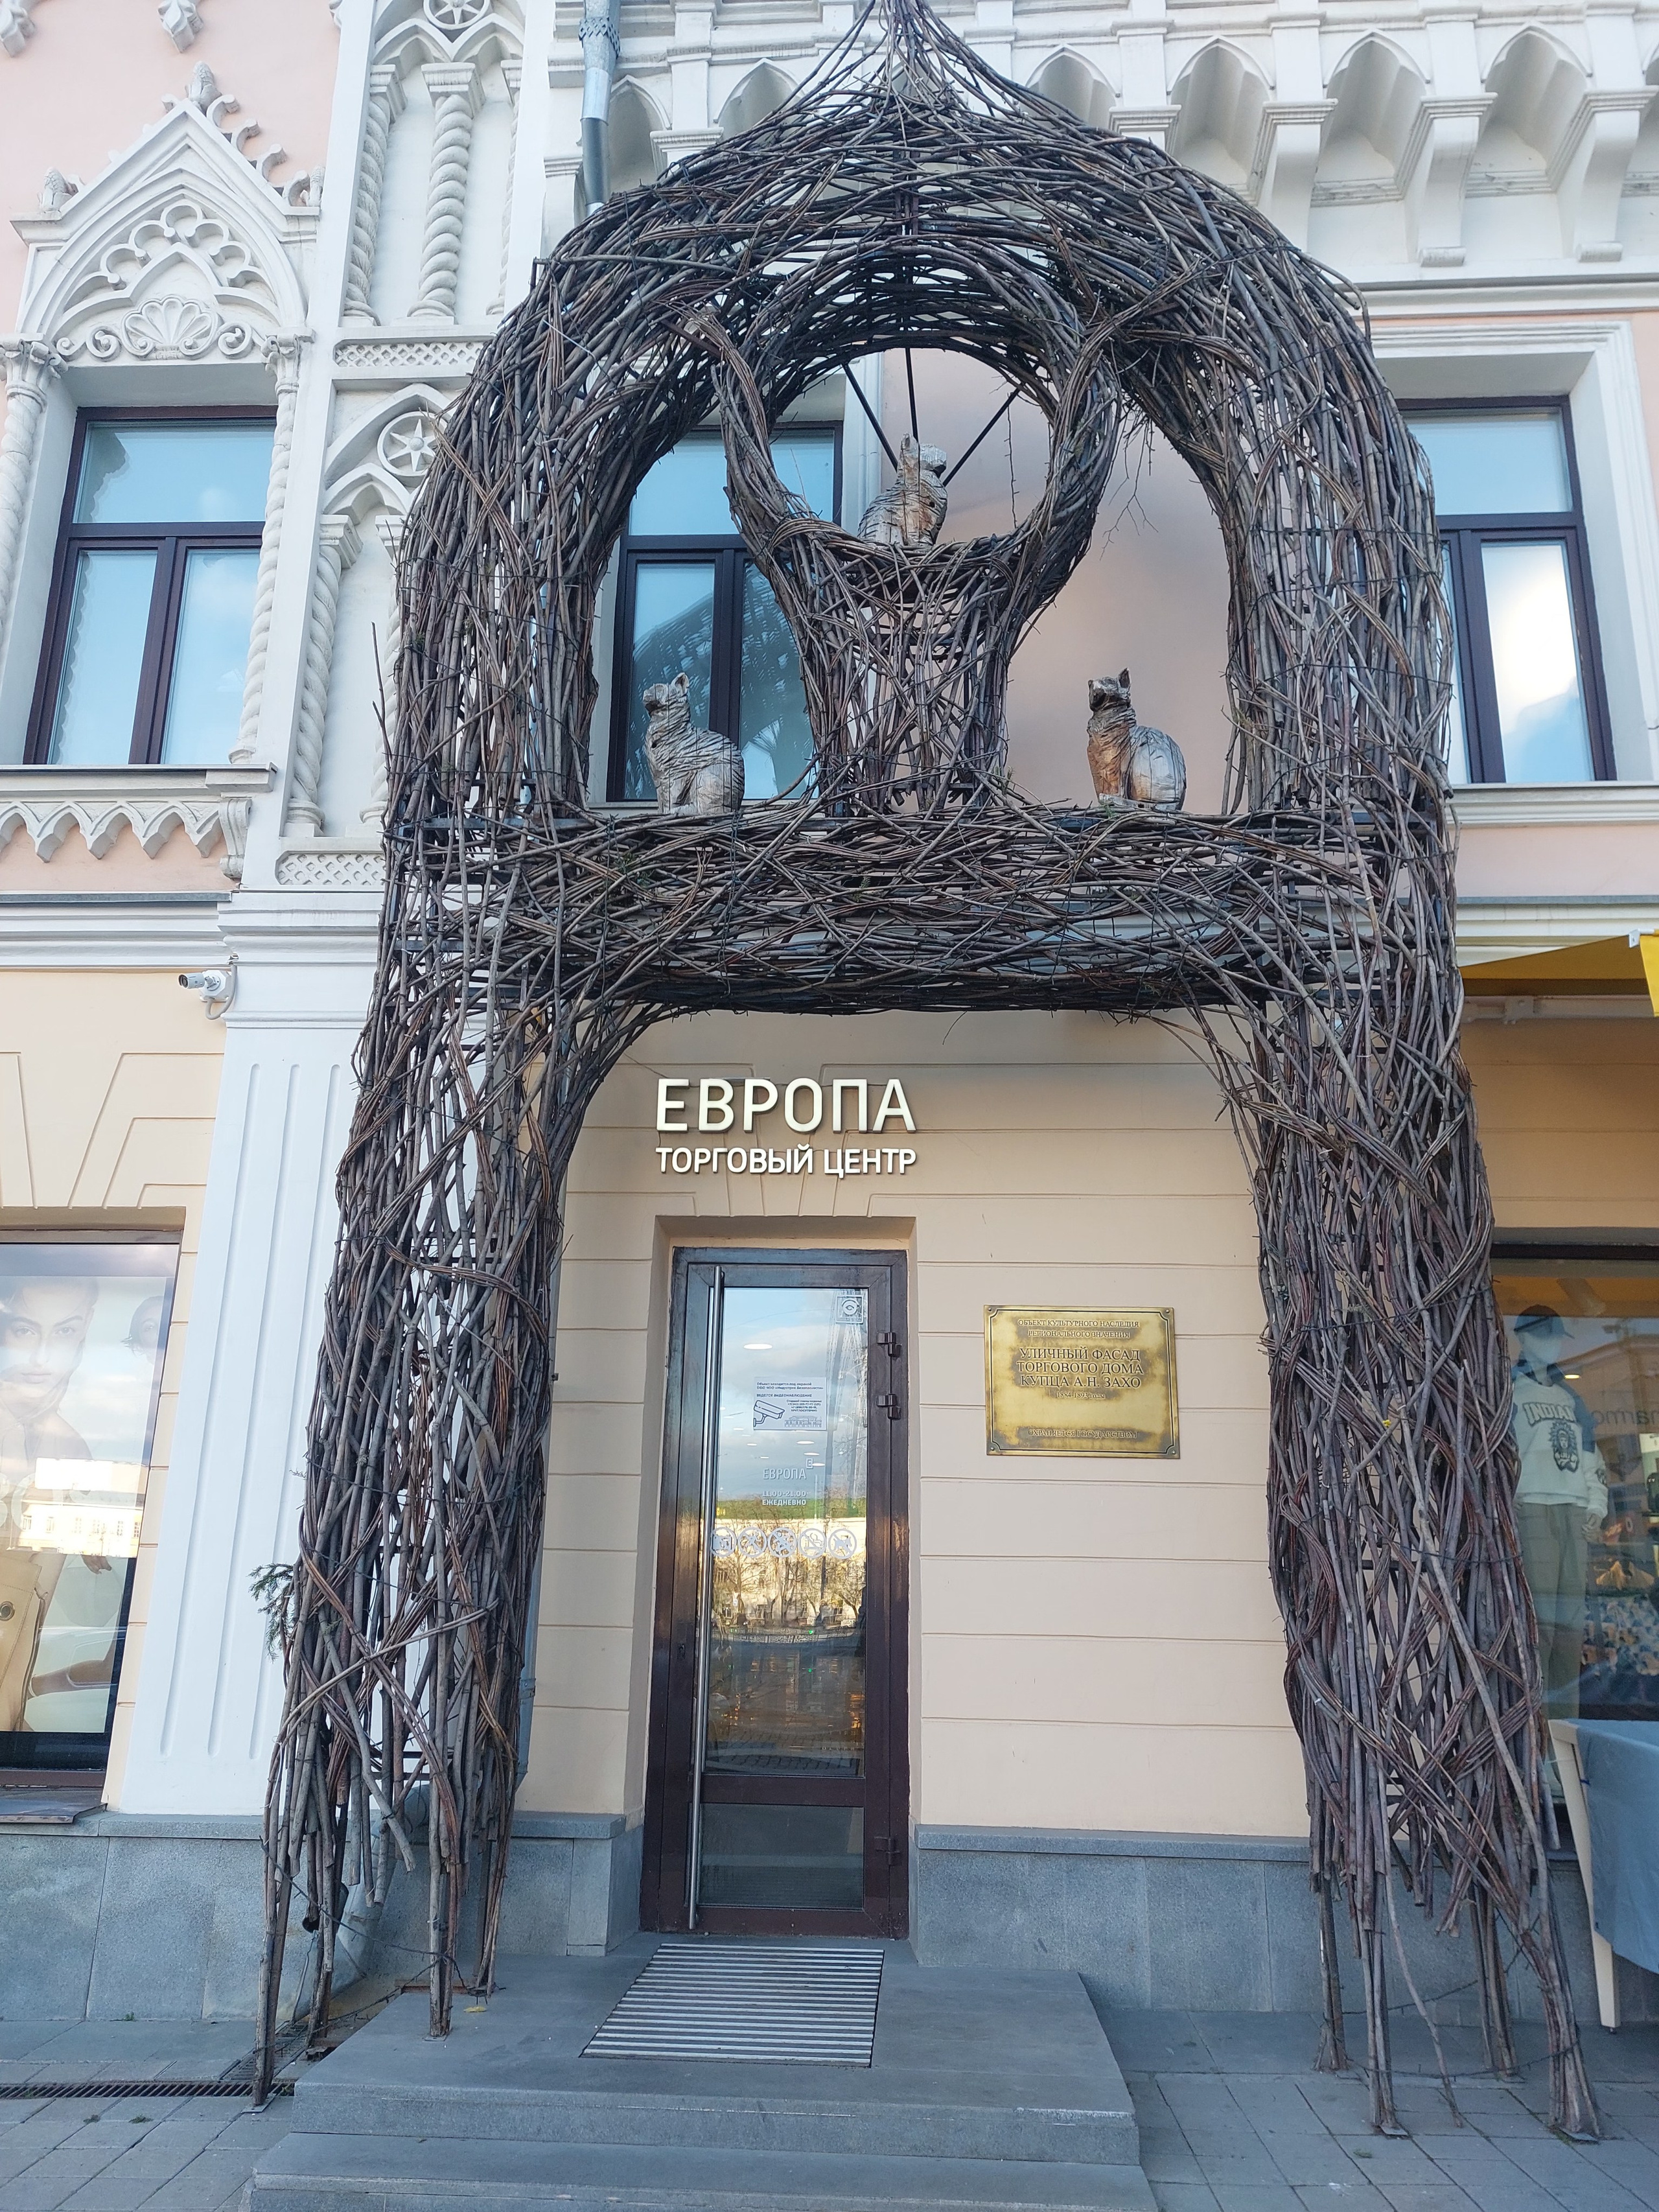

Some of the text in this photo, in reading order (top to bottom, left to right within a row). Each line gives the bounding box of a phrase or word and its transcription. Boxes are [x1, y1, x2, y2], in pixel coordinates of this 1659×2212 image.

[656, 1078, 916, 1133] ЕВРОПА
[655, 1143, 916, 1179] ТОРГОВЫЙ ЦЕНТР
[1019, 1346, 1140, 1362] УЛИЧНЫЙ ФАСАД
[1017, 1361, 1143, 1375] ТОРГОВОГО ДОМА
[1021, 1375, 1141, 1388] КУПЦА А.Н. ЗАХО
[763, 1469, 807, 1480] ЕВРОПА
